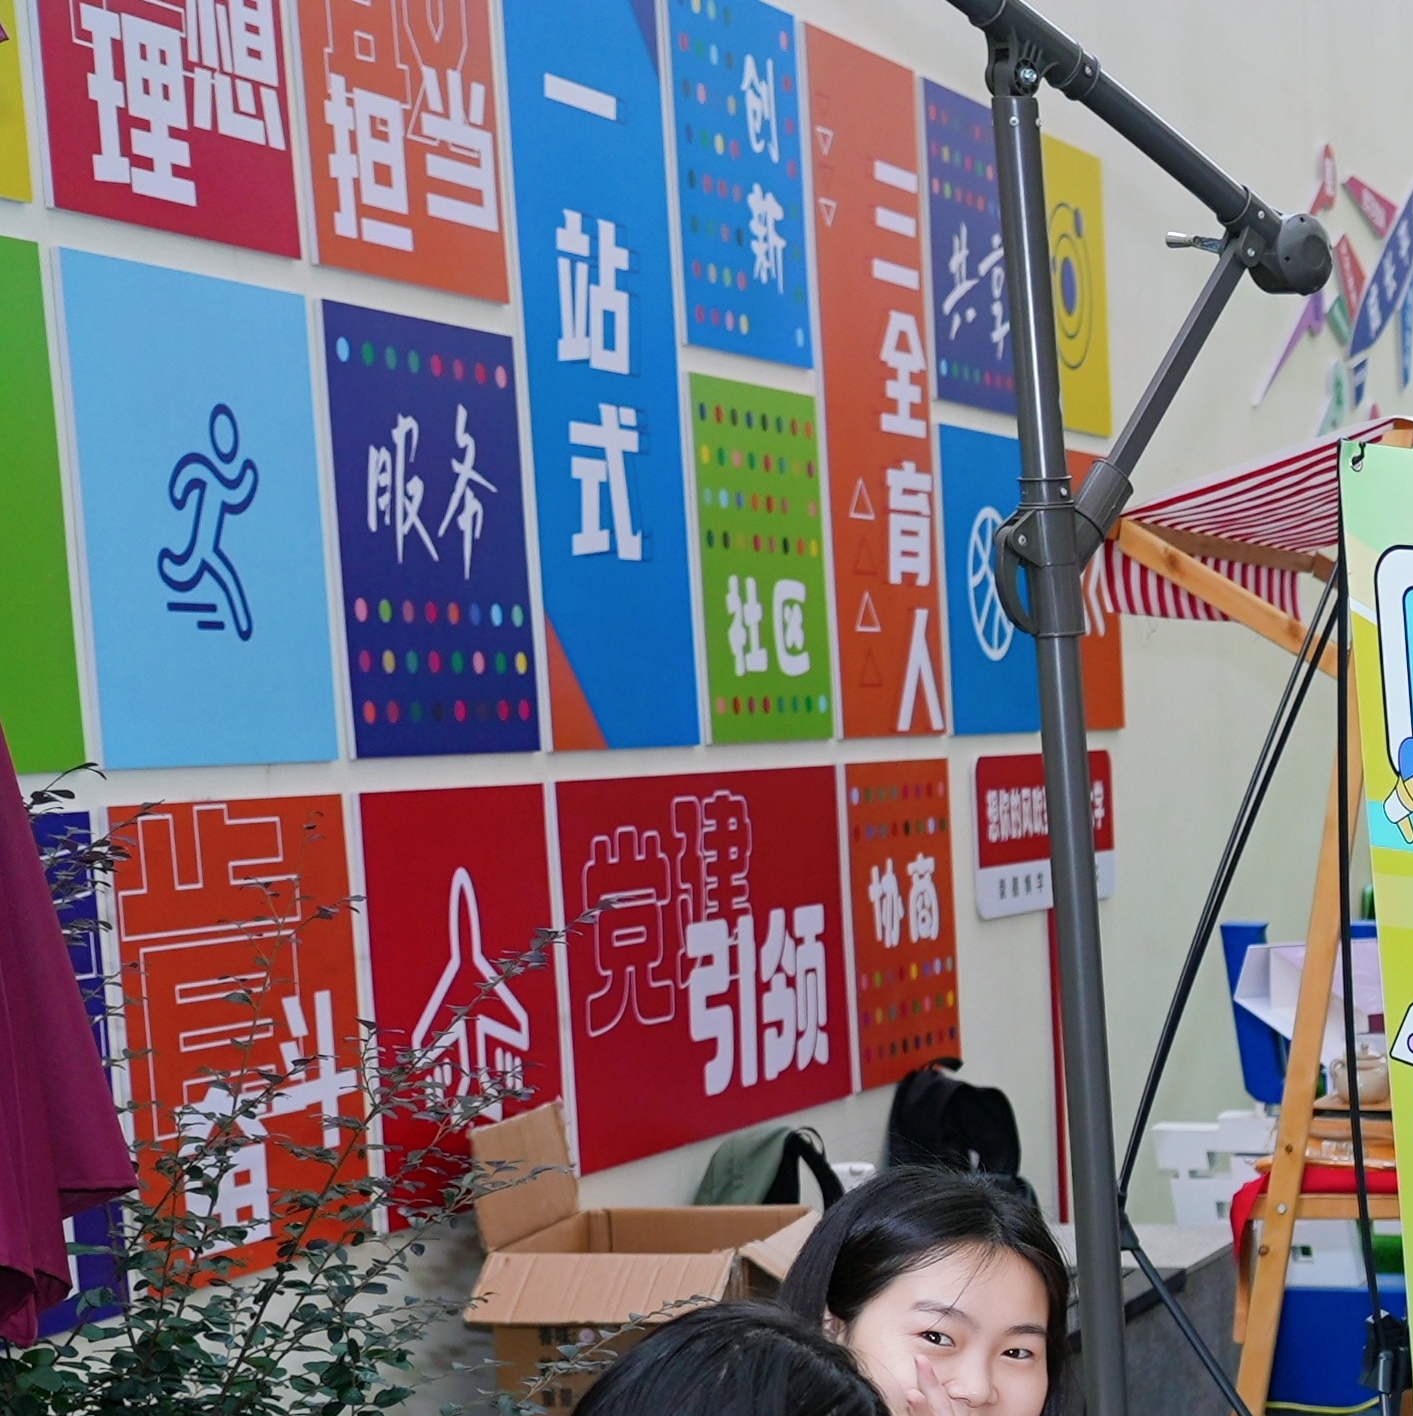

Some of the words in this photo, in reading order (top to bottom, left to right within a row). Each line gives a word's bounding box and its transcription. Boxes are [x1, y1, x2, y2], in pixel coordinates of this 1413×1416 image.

[81, 0, 286, 208] 理想
[322, 66, 499, 252] 担当
[739, 53, 787, 293] 创新
[544, 73, 643, 562] 一站式
[367, 403, 497, 580] 服务
[872, 159, 945, 732] 三全育人
[725, 575, 810, 677] 社区
[867, 851, 940, 949] 协商
[686, 903, 829, 1097] 引领
